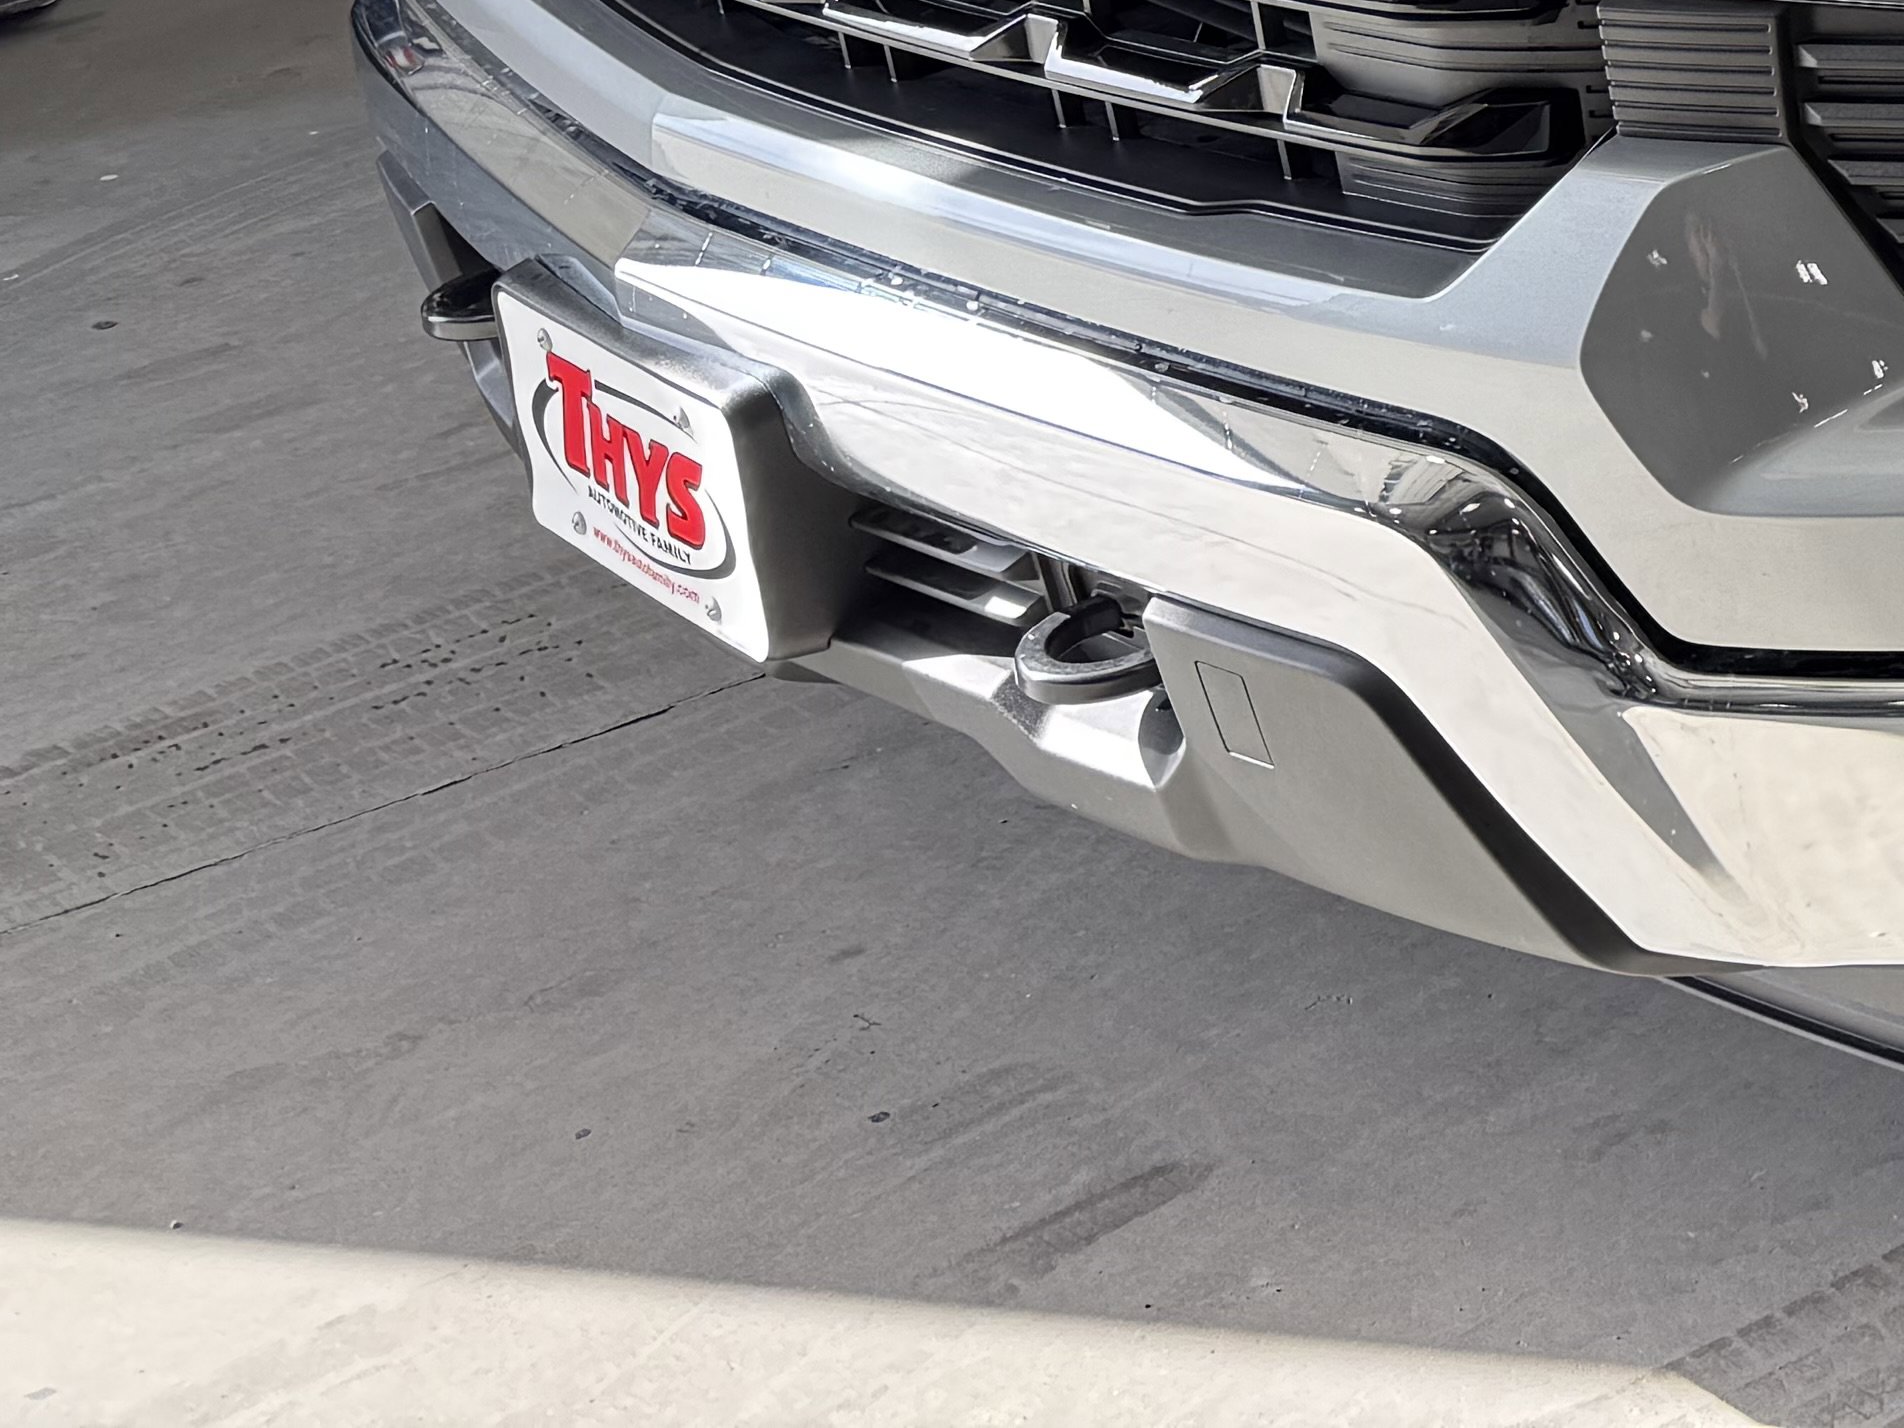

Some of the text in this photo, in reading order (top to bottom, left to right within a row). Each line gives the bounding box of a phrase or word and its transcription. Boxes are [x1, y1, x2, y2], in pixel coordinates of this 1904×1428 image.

[546, 351, 705, 551] THYS
[588, 485, 692, 566] AUTOMOTIVE FAMILY
